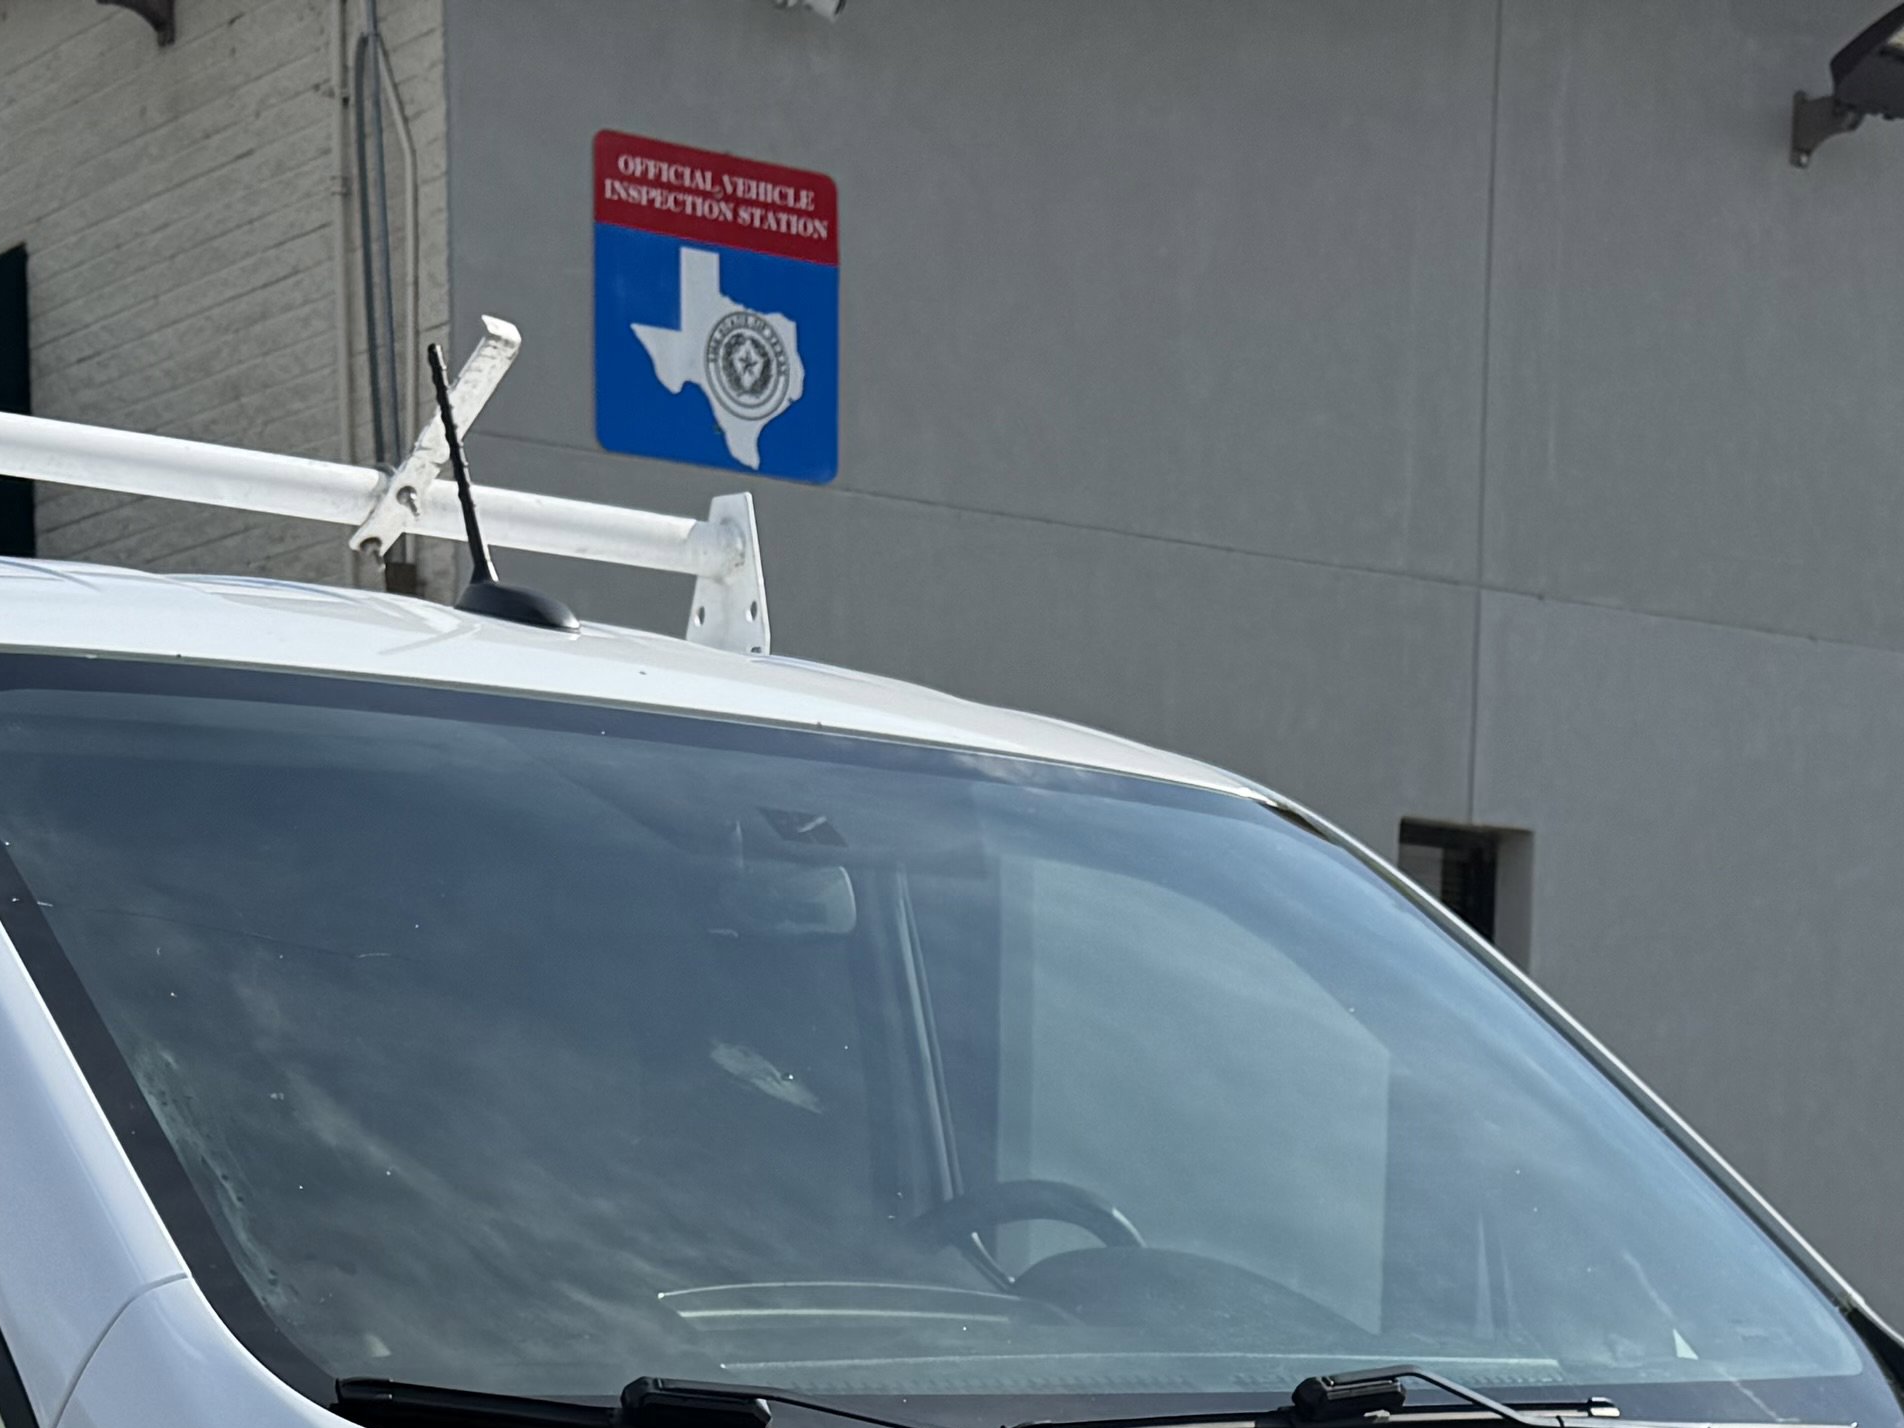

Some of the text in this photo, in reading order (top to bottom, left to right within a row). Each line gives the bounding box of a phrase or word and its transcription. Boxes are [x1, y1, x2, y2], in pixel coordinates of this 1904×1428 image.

[603, 178, 829, 240] INSPECTION STATION
[617, 154, 816, 212] OFFICIAL VEHICLE
